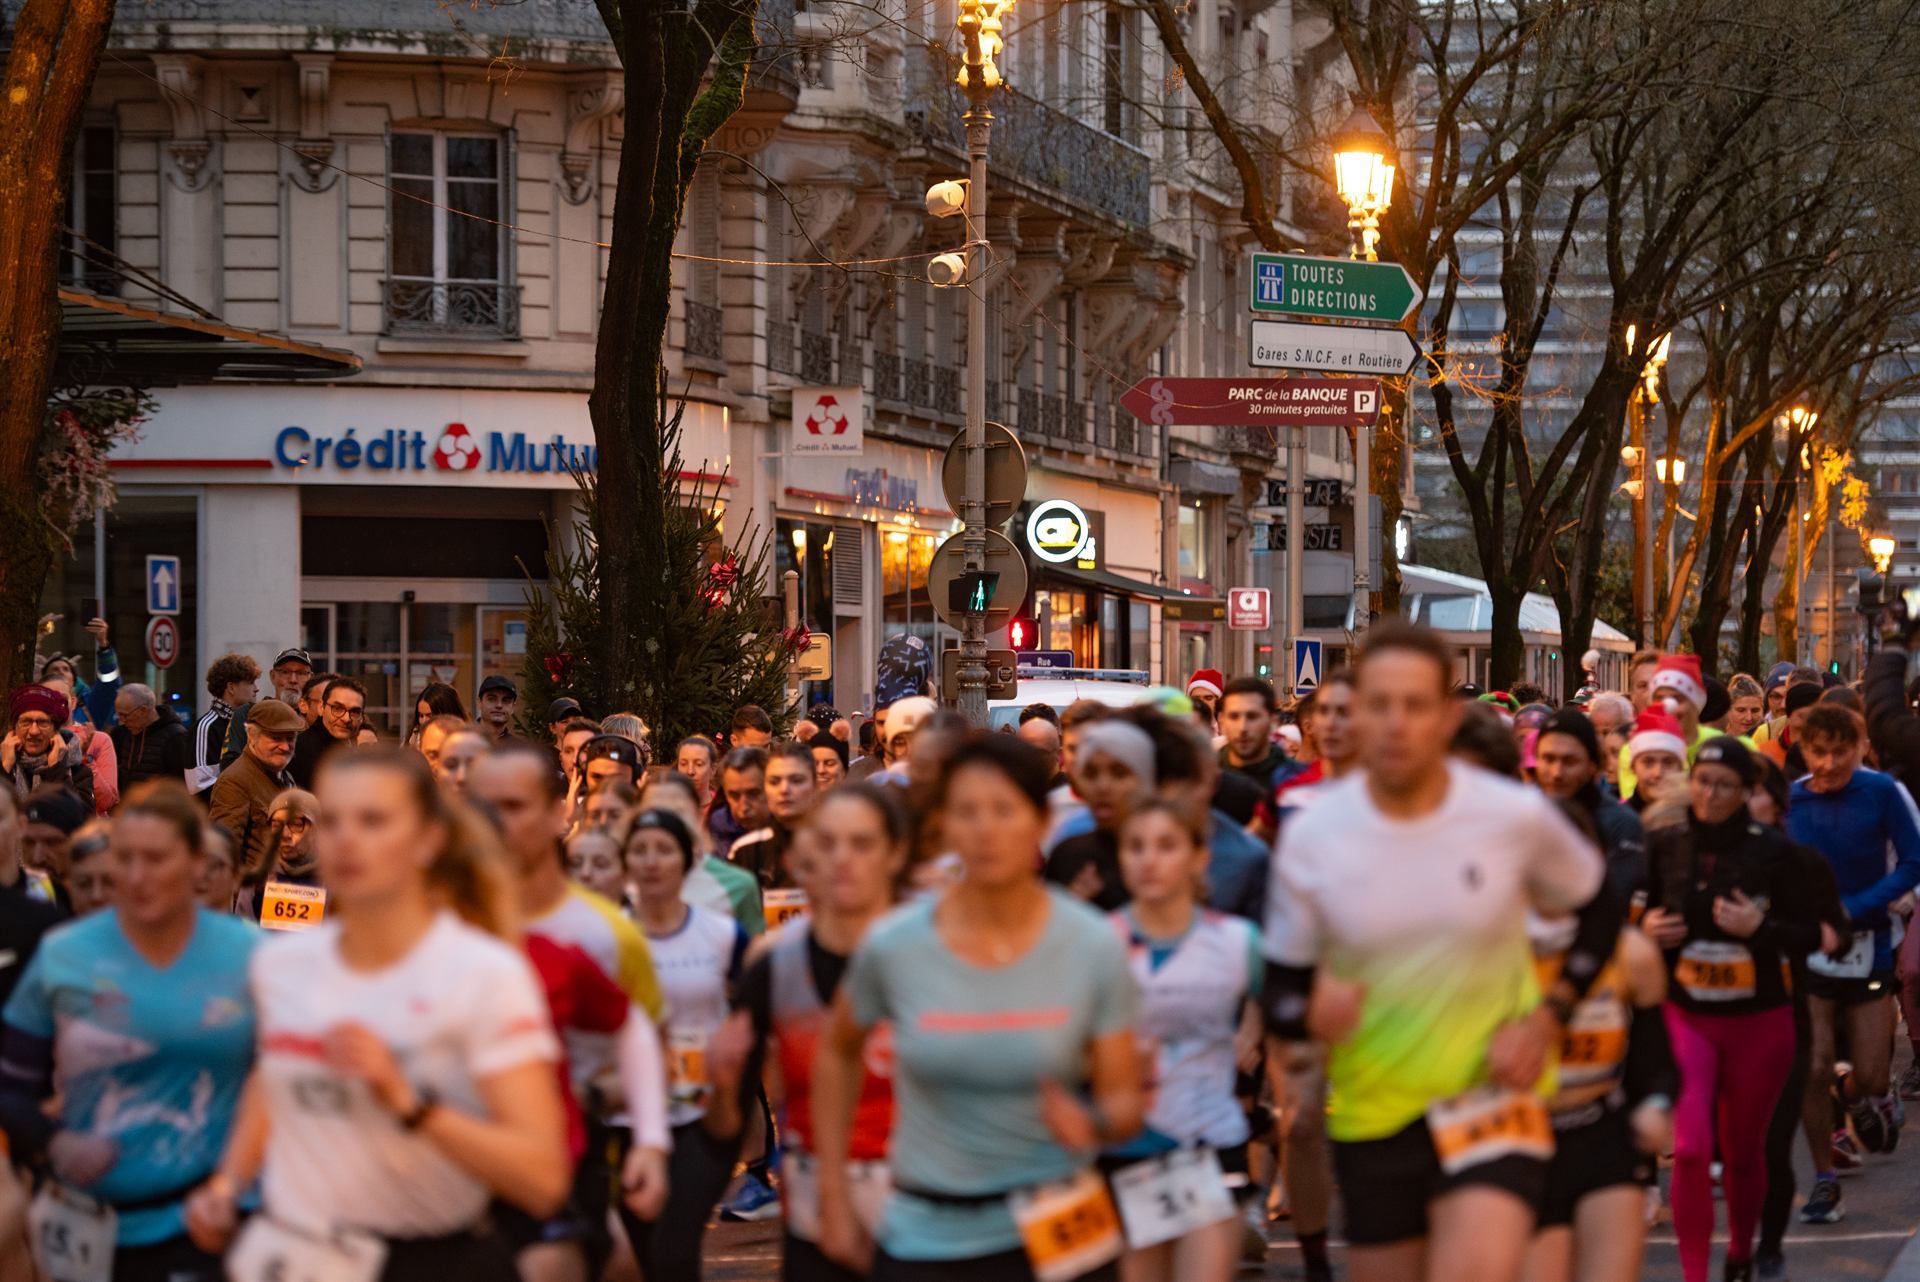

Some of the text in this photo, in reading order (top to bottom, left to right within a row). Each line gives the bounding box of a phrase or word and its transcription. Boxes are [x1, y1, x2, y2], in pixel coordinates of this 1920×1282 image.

[1292, 264, 1344, 285] TOUTES
[1291, 287, 1377, 312] DIRECTIONS
[1257, 346, 1403, 368] Gares S.N.C.F. et Routière
[1228, 387, 1348, 402] PARC de la BANQUE
[1359, 394, 1370, 411] P
[1248, 403, 1348, 417] 30 minutes gratuites
[275, 426, 598, 472] Crédit Mutu
[155, 631, 172, 653] 30
[1037, 656, 1052, 667] Rue
[273, 900, 310, 920] 652
